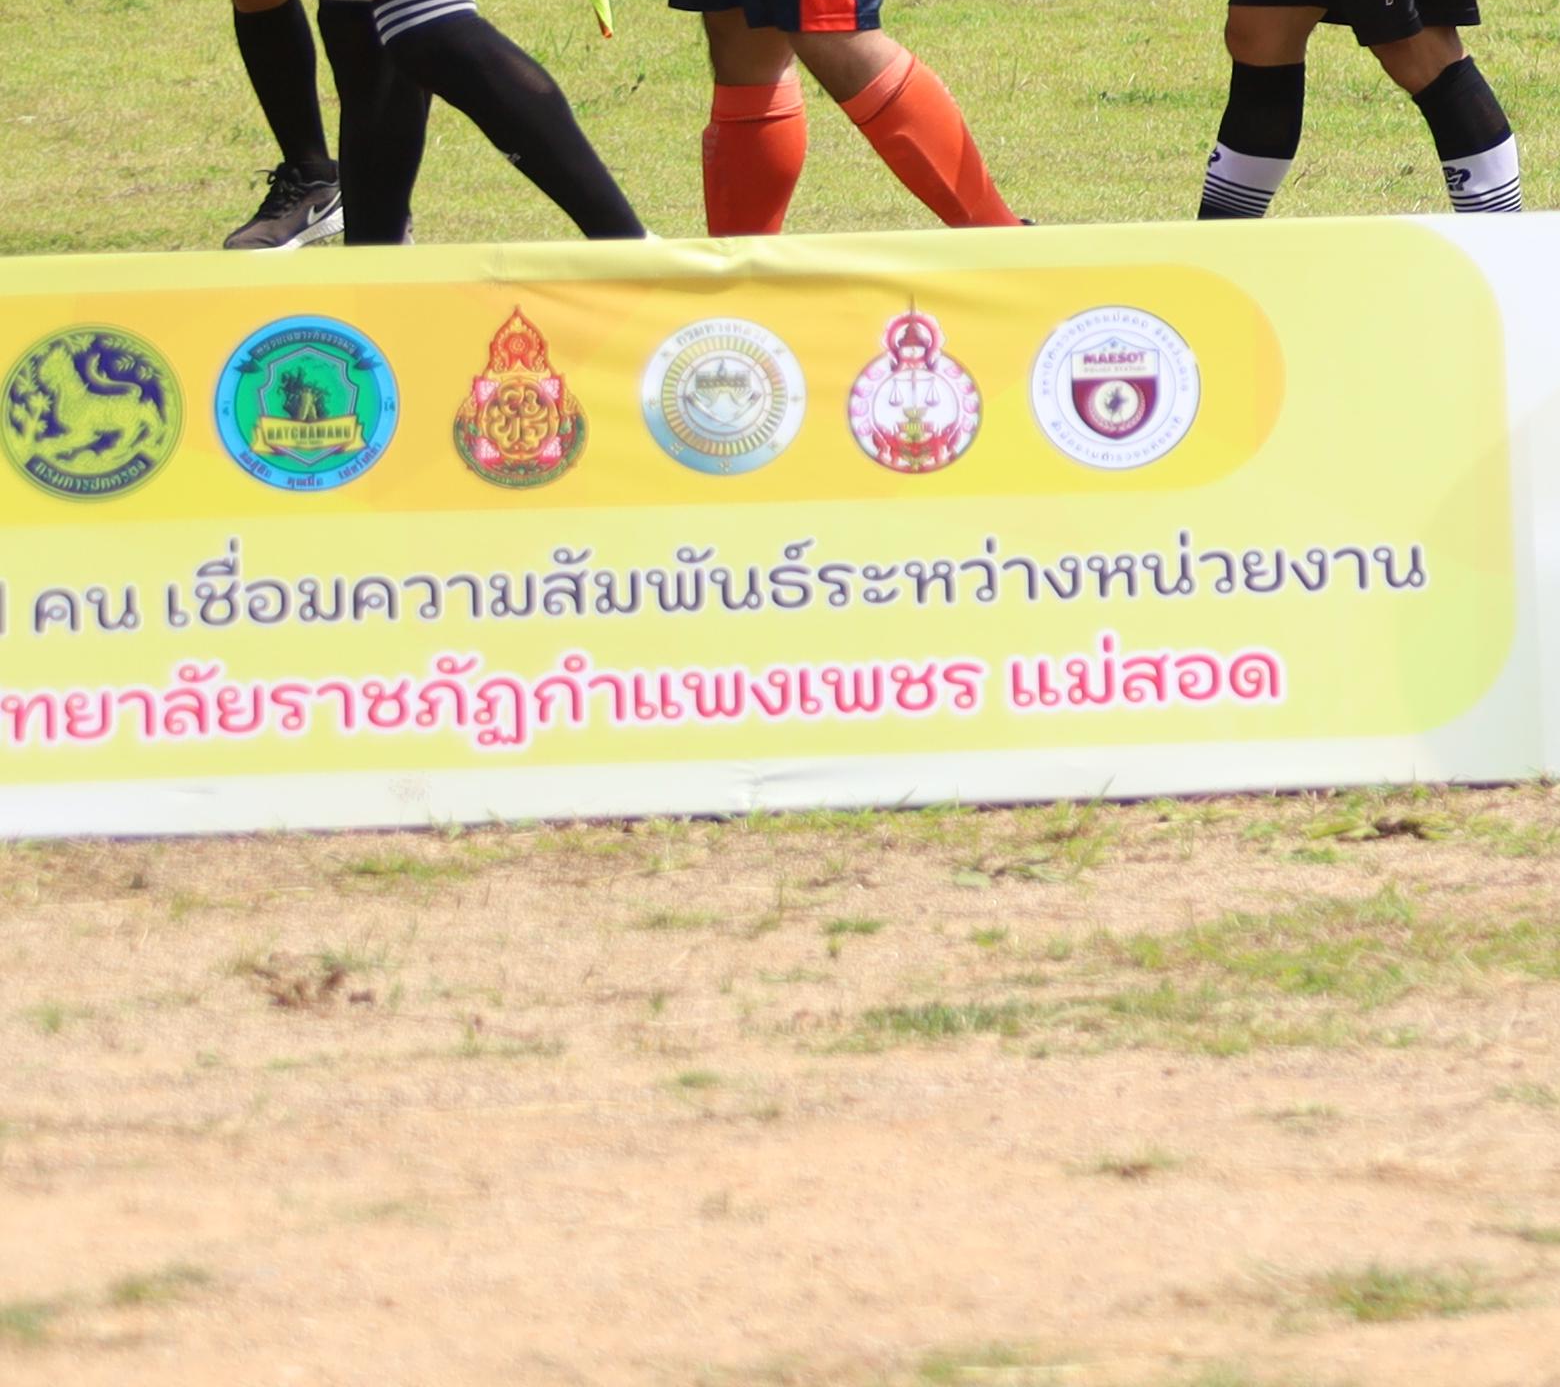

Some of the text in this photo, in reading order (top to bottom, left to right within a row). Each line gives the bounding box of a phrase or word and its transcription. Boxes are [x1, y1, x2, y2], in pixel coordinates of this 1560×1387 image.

[1083, 351, 1147, 365] MAESOT
[34, 585, 141, 634] คน
[166, 530, 1428, 628] เชื่อมความสัมพันธ์ระหว่างหน่วยงาน
[1010, 635, 1281, 709] แม่สอด
